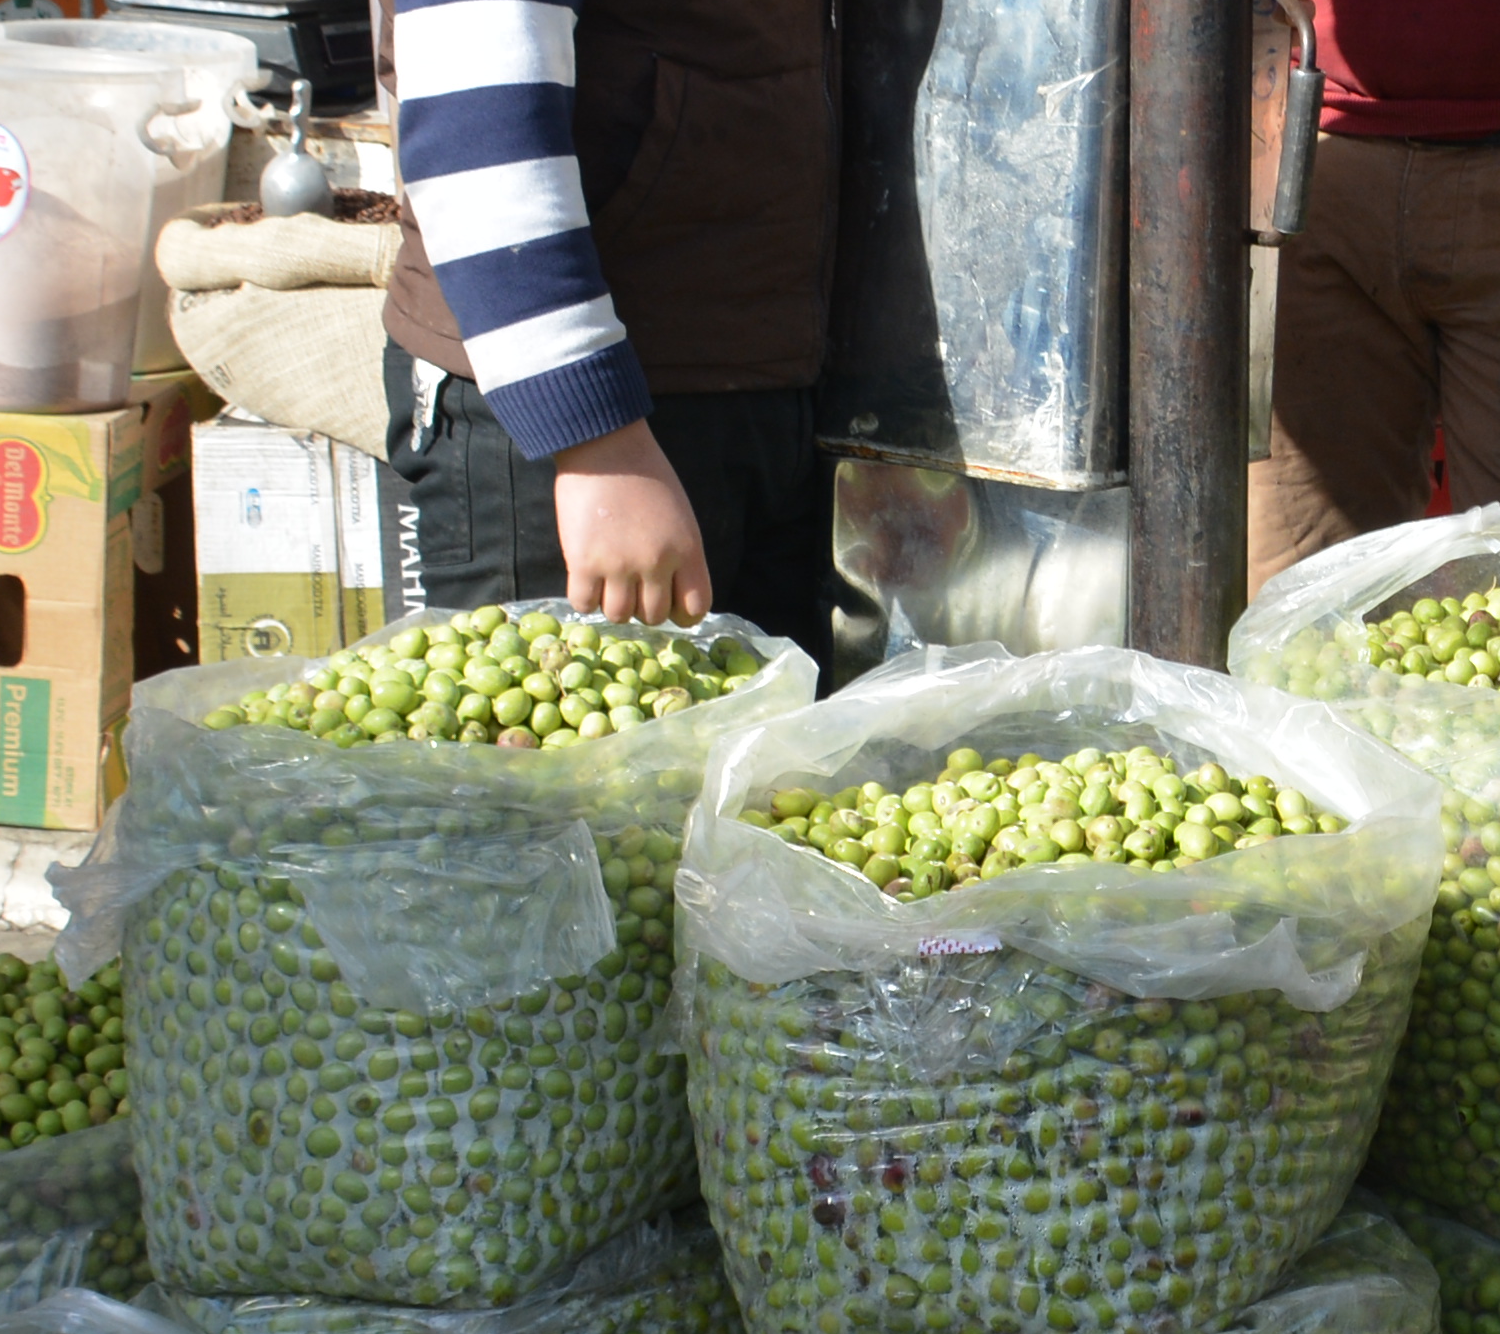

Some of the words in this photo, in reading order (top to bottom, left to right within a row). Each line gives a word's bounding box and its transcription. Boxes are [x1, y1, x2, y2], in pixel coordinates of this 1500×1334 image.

[3, 446, 26, 479] Del
[2, 483, 25, 547] Monte
[2, 683, 28, 798] Premium
